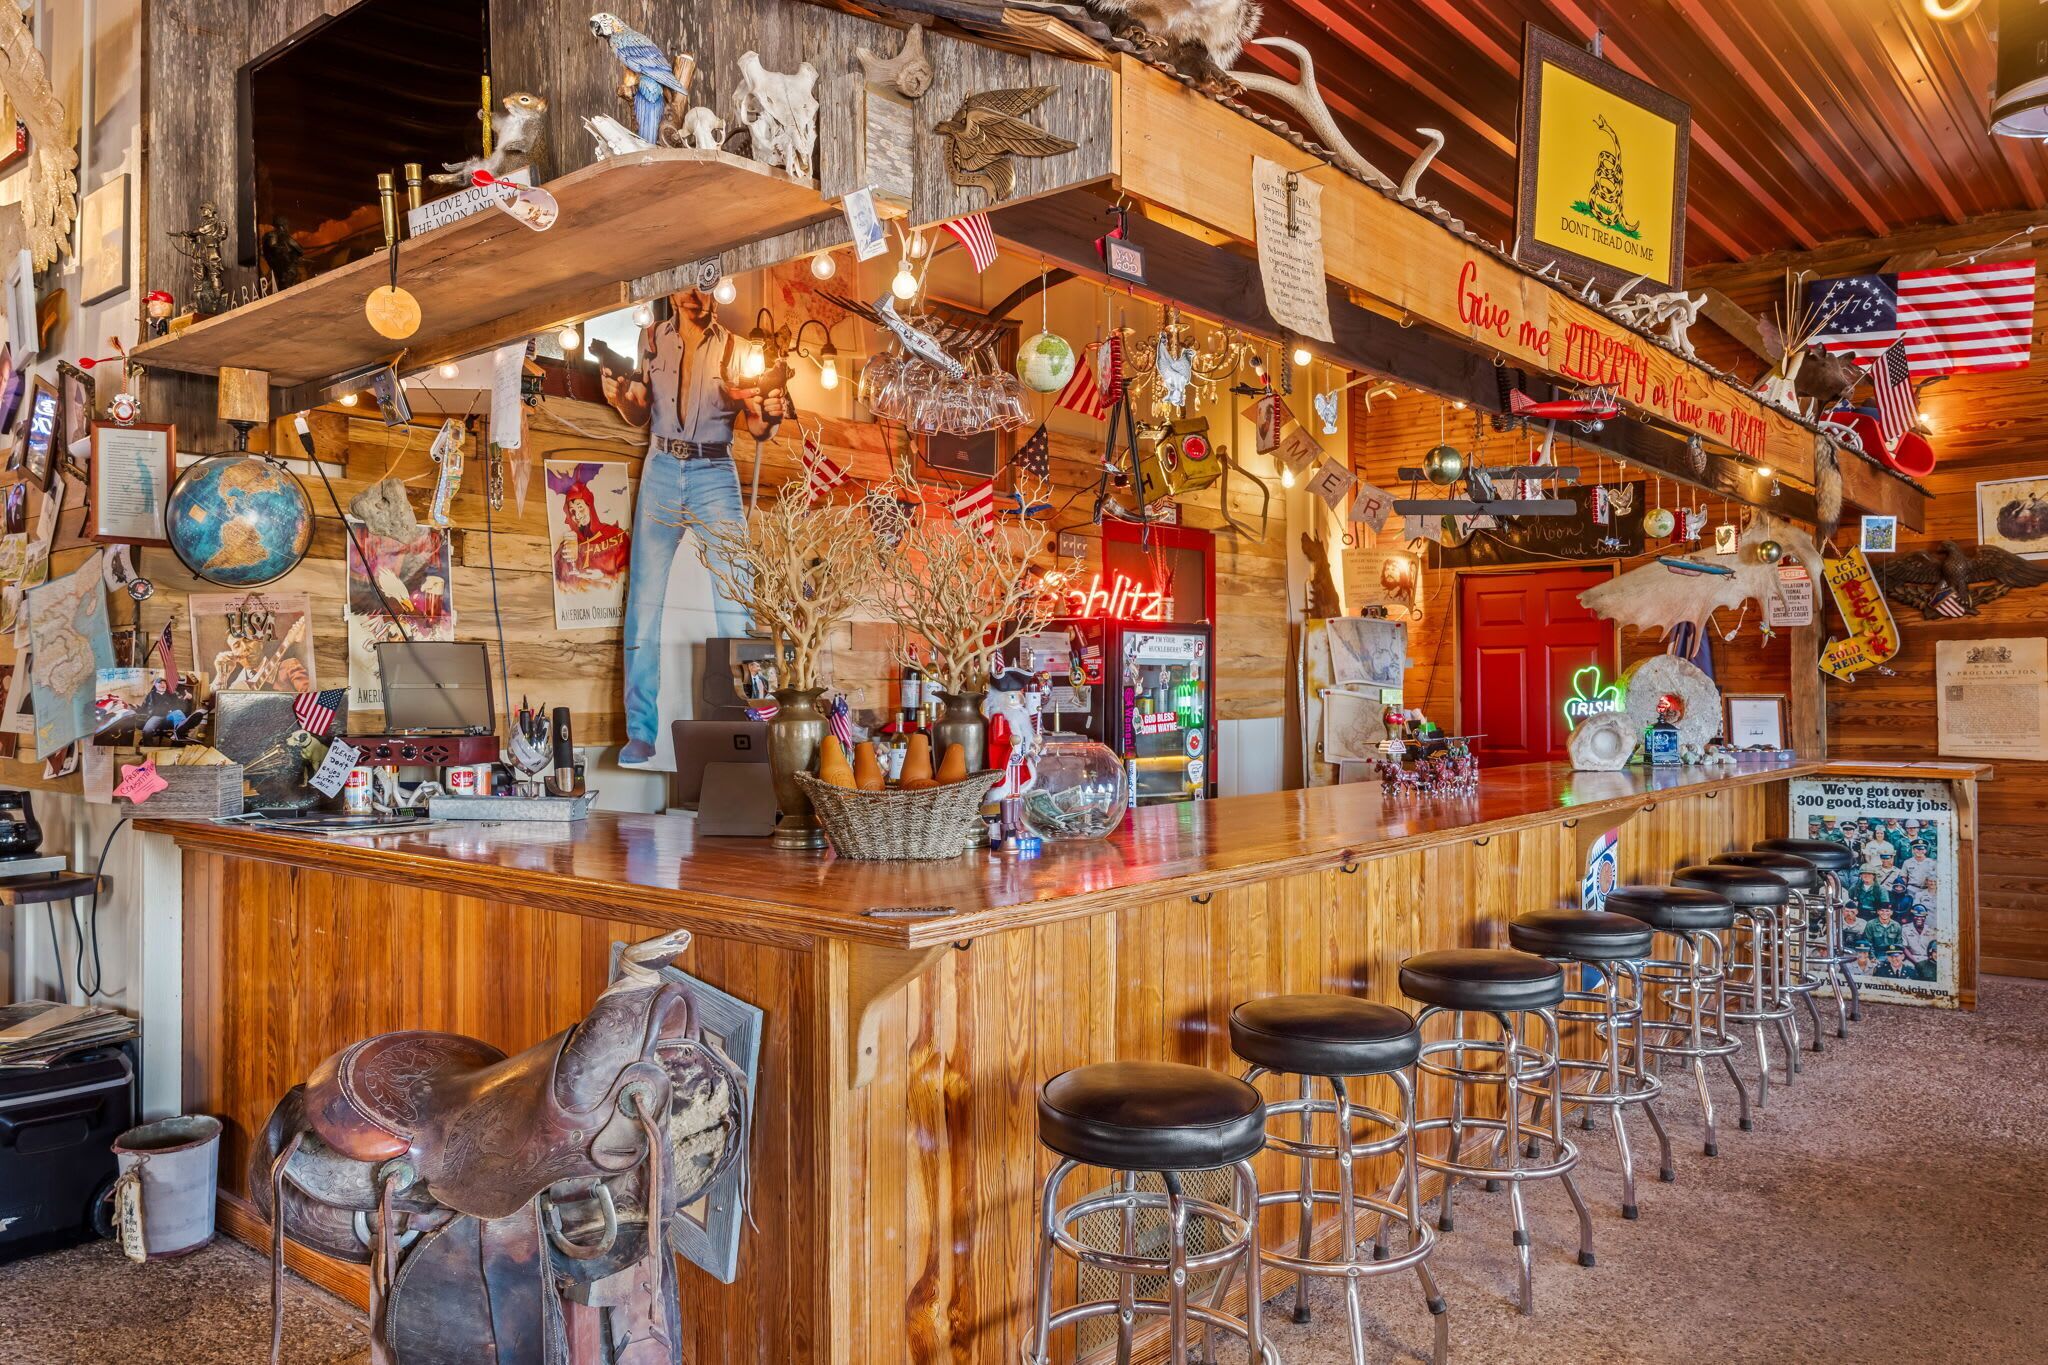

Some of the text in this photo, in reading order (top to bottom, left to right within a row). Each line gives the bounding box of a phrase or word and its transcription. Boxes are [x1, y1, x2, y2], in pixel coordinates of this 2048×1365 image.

[958, 176, 981, 184] FIRST
[424, 208, 430, 218] I
[432, 194, 462, 216] LOVE
[464, 184, 490, 204] YOU
[411, 221, 433, 238] THE
[436, 208, 468, 228] MOON
[472, 198, 496, 214] AND
[1560, 216, 1654, 262] DONT TREAD ON ME
[1116, 248, 1136, 264] YAY
[1114, 260, 1138, 272] GOD
[1834, 296, 1872, 314] 1776
[1457, 260, 1768, 461] Give me LIBERTY or Give me DEATH
[578, 530, 626, 570] FAUST
[1834, 560, 1857, 574] ICE
[1830, 566, 1868, 585] COLD
[561, 606, 624, 621] AMERICAN ORIGINALS
[226, 610, 279, 641] USA
[1829, 645, 1861, 662] SOLD
[1832, 654, 1866, 670] HERE
[1571, 701, 1615, 716] IRISH
[1144, 712, 1174, 724] GOD BLESS
[1142, 722, 1178, 734] JOHN WAYNE
[332, 745, 356, 763] PLEASE
[1822, 784, 1925, 798] We've got over
[1796, 795, 1952, 812] 300 good, steady jobs.
[1864, 982, 1894, 992] wants
